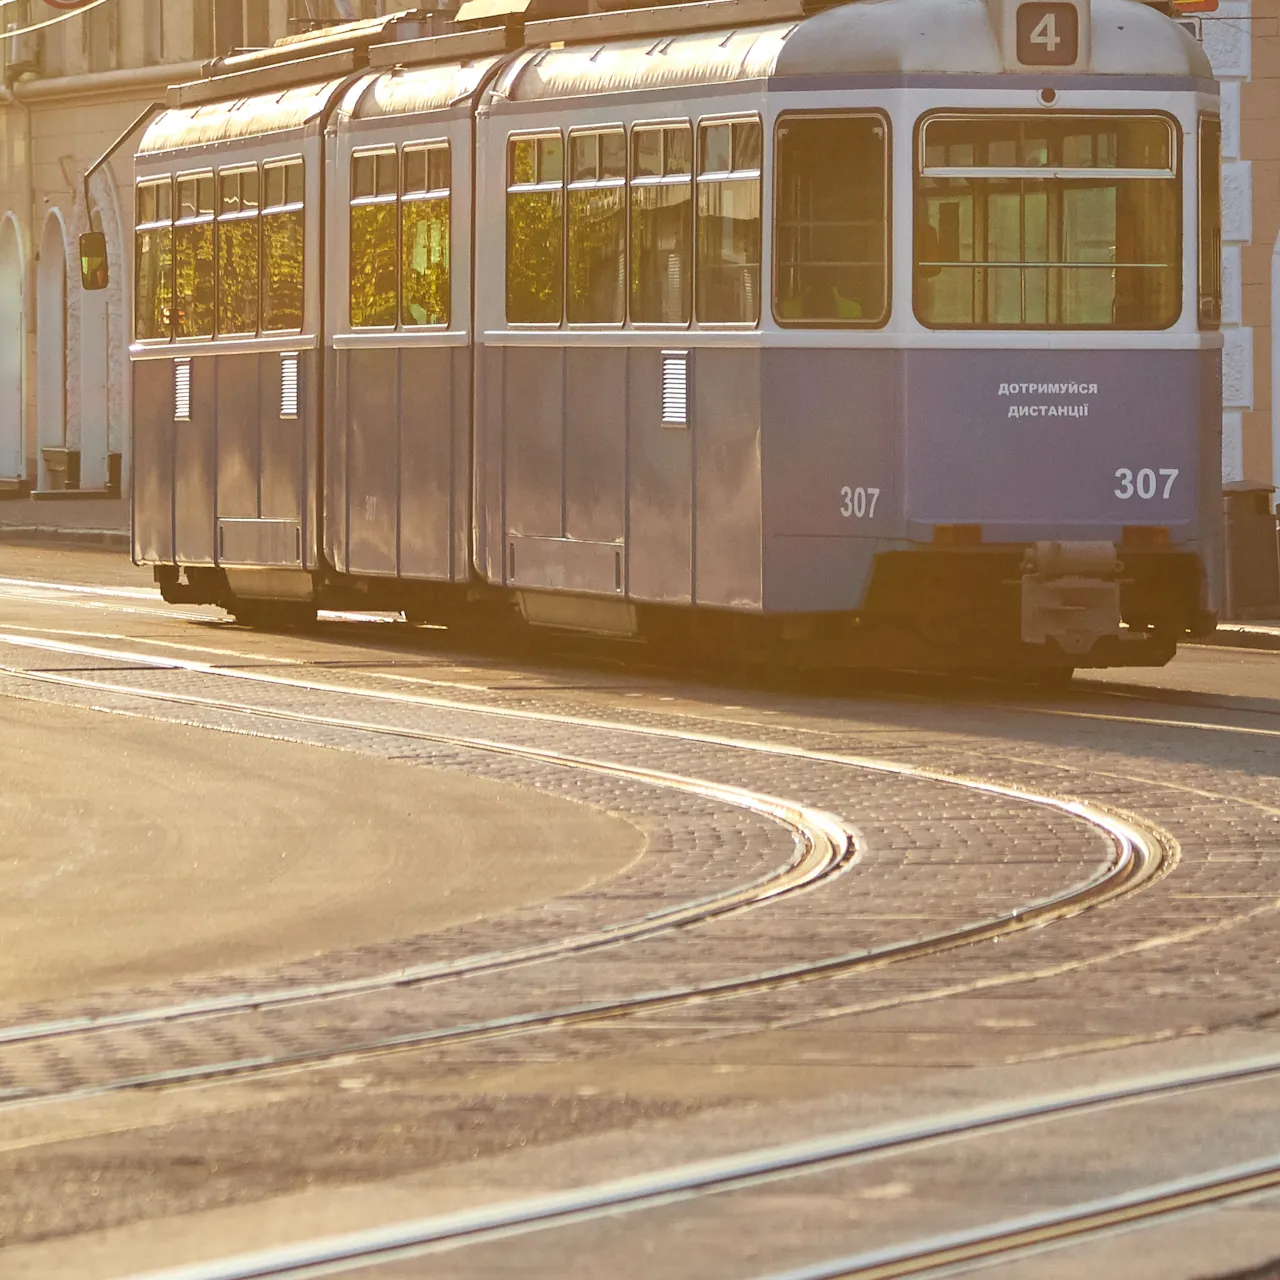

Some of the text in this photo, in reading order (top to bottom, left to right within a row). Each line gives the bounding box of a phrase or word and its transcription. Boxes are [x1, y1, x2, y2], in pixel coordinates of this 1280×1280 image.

[1029, 13, 1061, 52] 4
[998, 381, 1098, 395] ДОТРИМУЙСЯ
[1008, 403, 1089, 418] ДИСТАНЦІЇ
[1114, 468, 1179, 499] 307
[840, 485, 880, 518] 307
